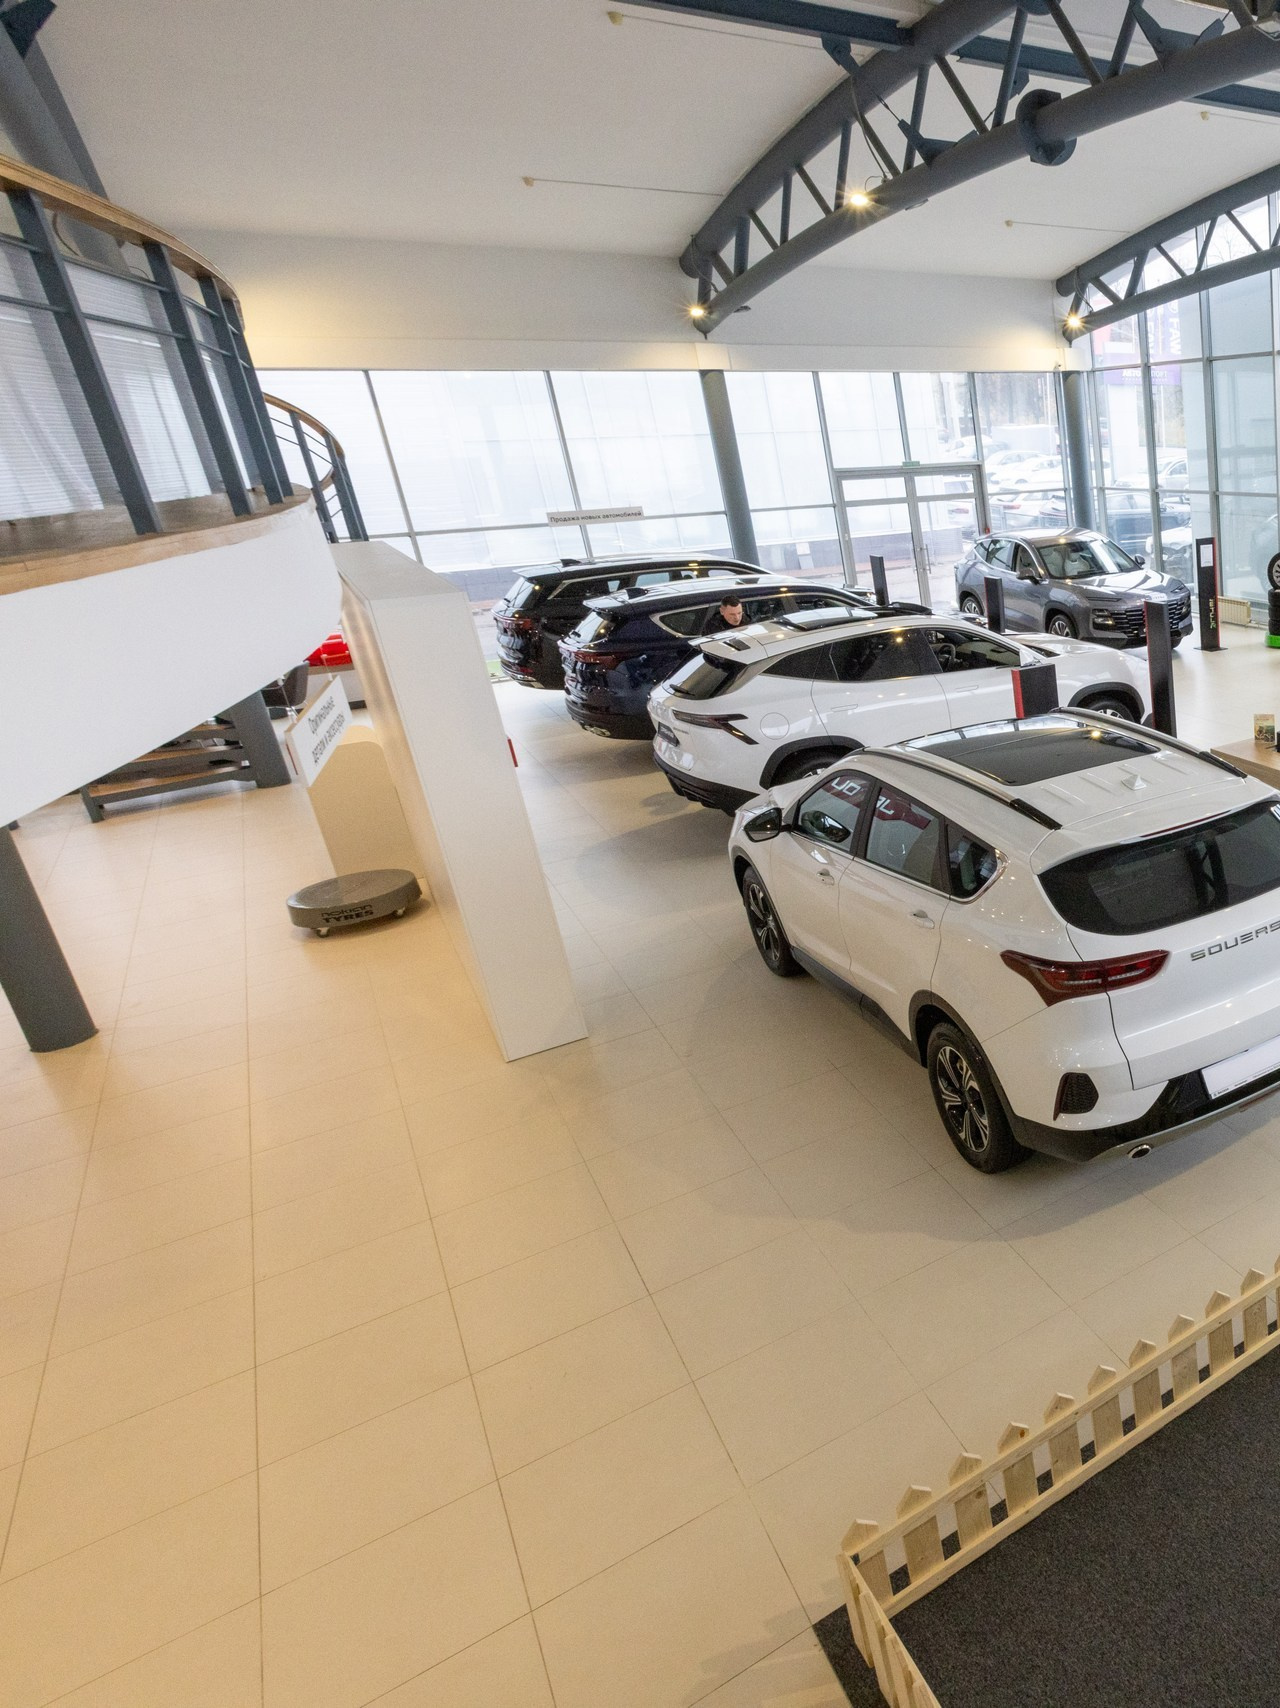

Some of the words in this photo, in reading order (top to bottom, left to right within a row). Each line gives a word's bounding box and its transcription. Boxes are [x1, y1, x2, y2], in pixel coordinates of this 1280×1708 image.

[1169, 317, 1181, 355] FAW
[602, 511, 642, 519] автомобилей
[321, 904, 373, 917] nokian
[322, 909, 374, 923] TYRES
